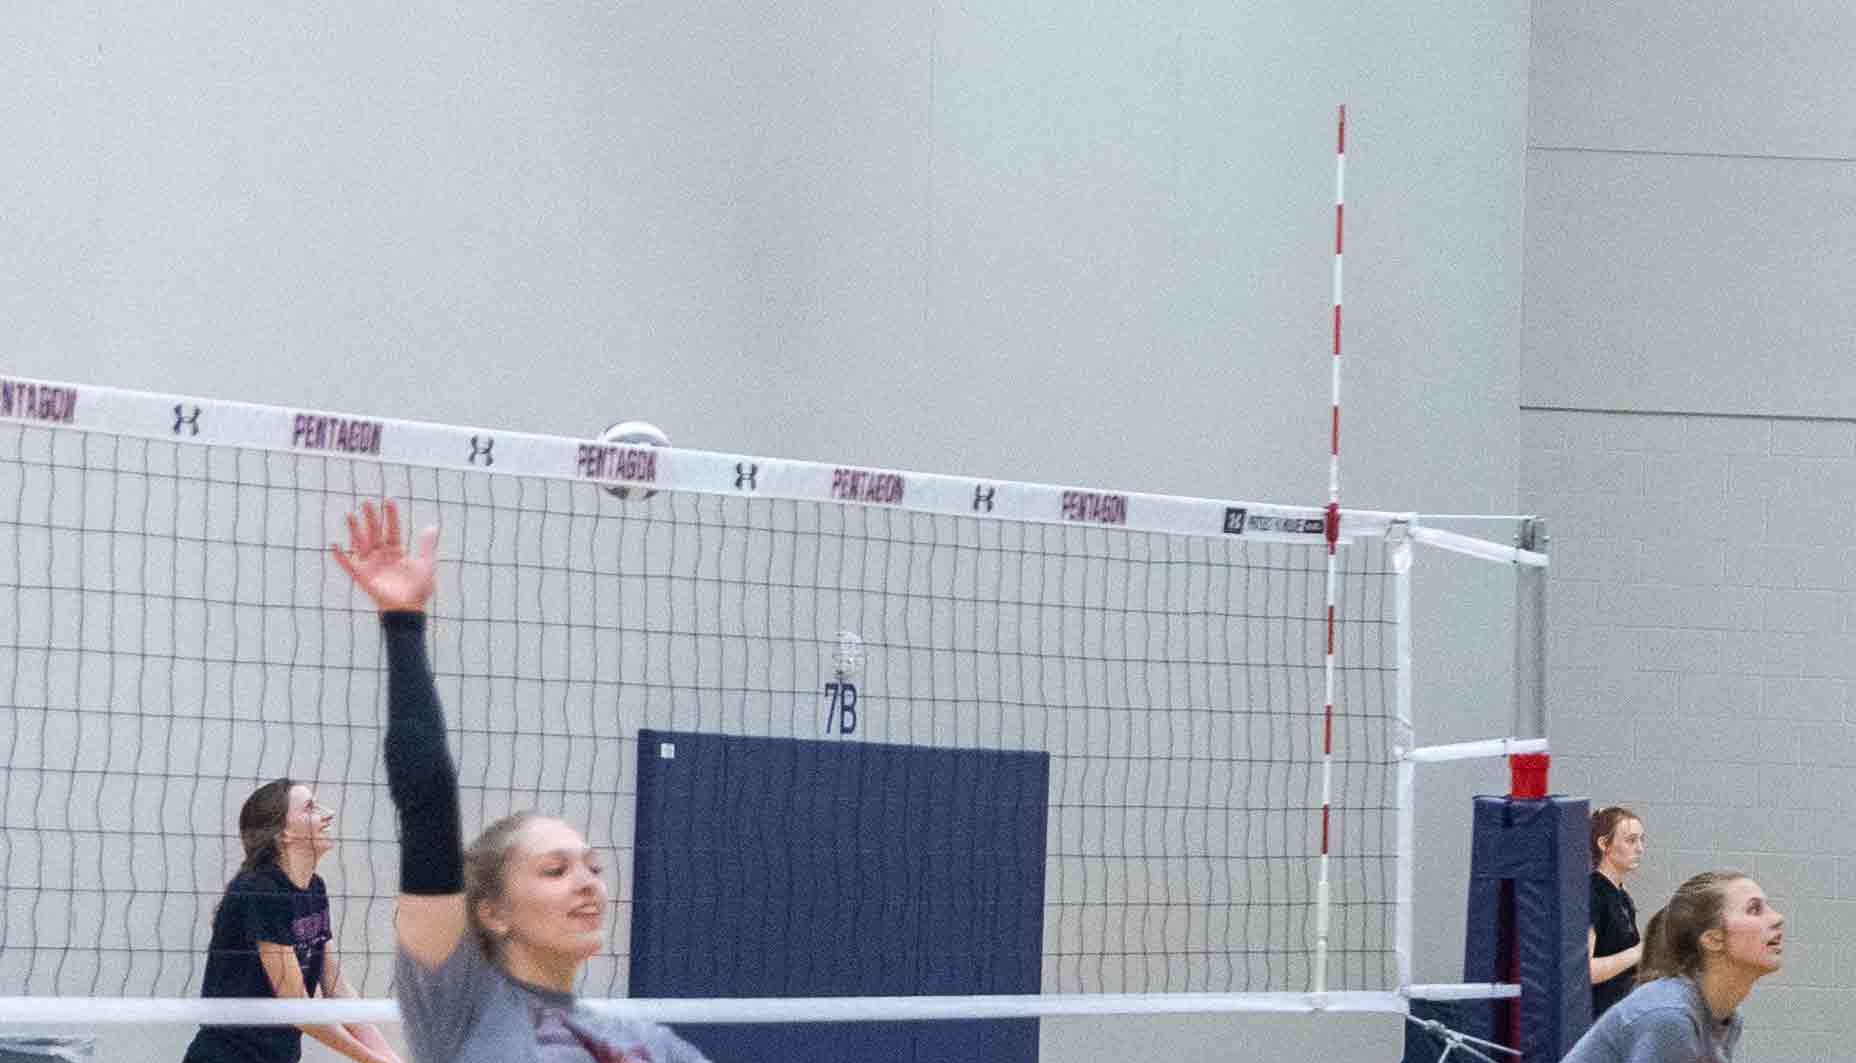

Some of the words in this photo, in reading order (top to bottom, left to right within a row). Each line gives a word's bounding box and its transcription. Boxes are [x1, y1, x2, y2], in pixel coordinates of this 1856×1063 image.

[293, 413, 384, 455] PENTAGON
[575, 444, 656, 482] PENTAGON
[831, 468, 905, 504] PENTAGON
[1061, 490, 1128, 526] PENTAGON
[825, 683, 857, 734] 7B
